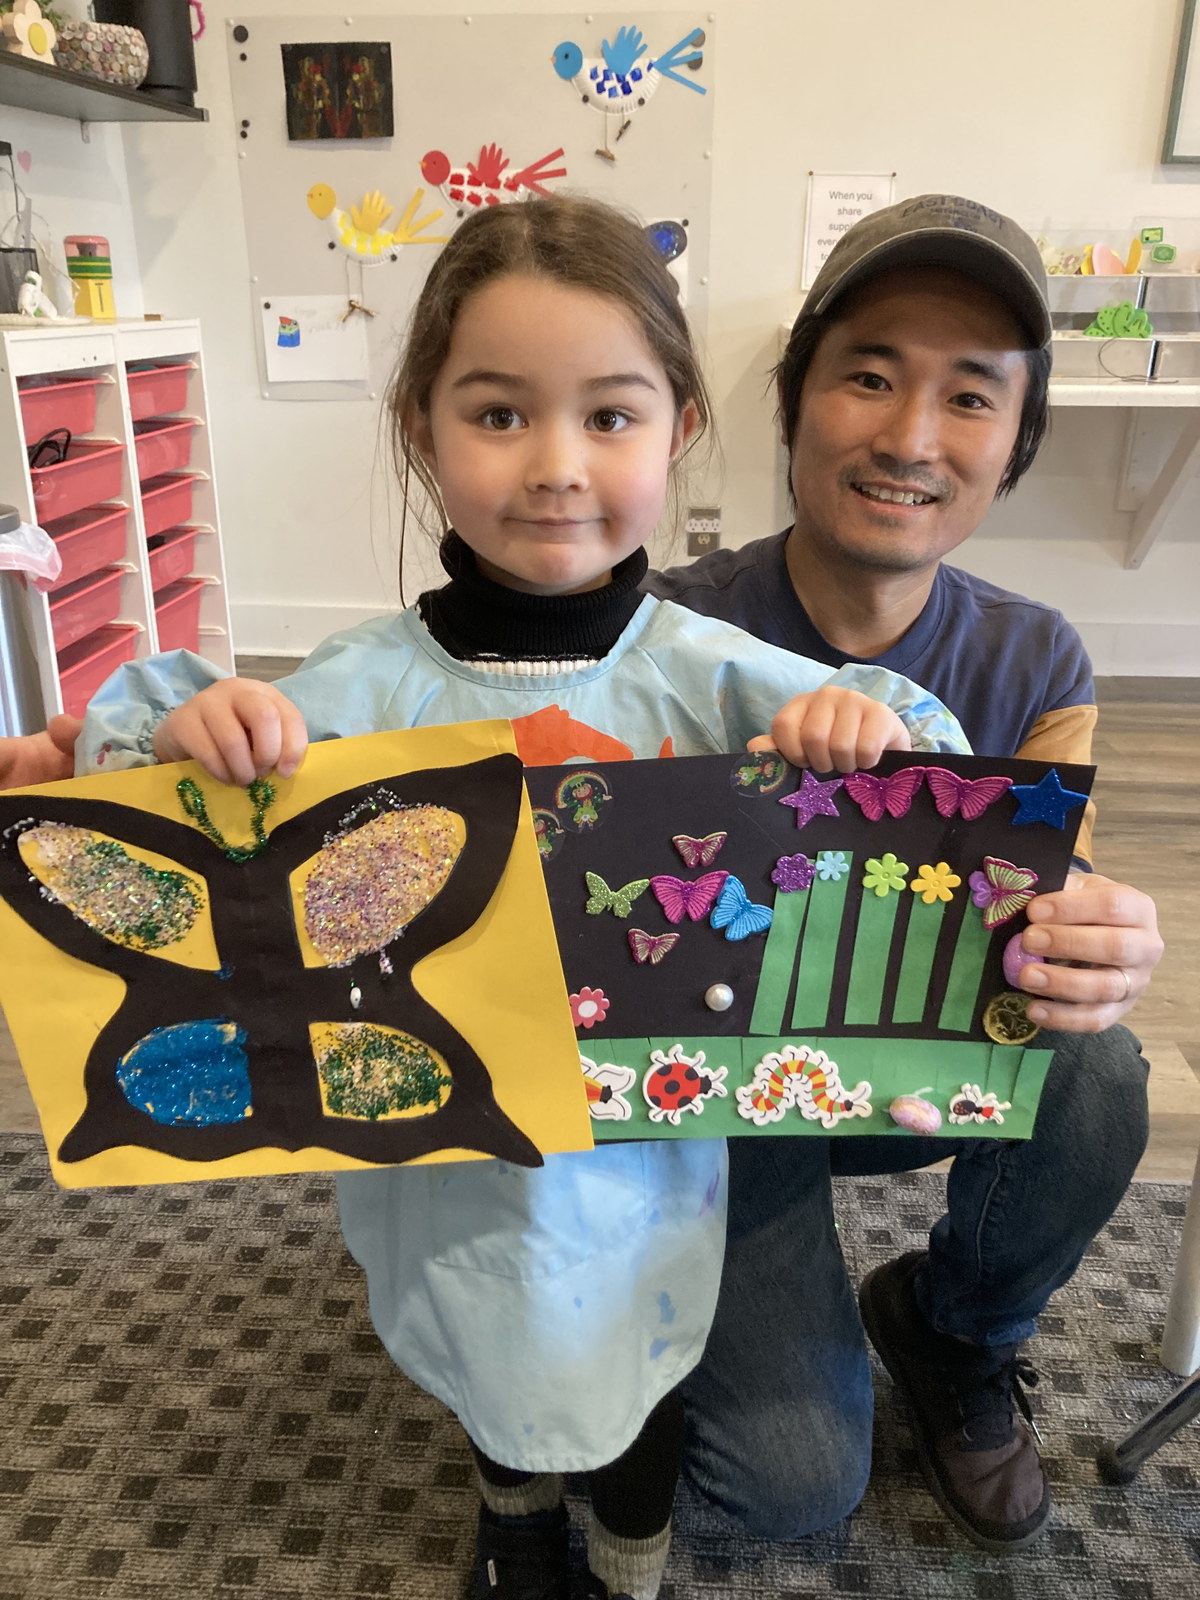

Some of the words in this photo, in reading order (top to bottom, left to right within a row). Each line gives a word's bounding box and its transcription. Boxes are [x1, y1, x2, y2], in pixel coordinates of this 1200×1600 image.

[829, 190, 855, 200] When
[856, 192, 873, 202] you
[837, 207, 862, 216] share
[902, 195, 948, 217] EAST
